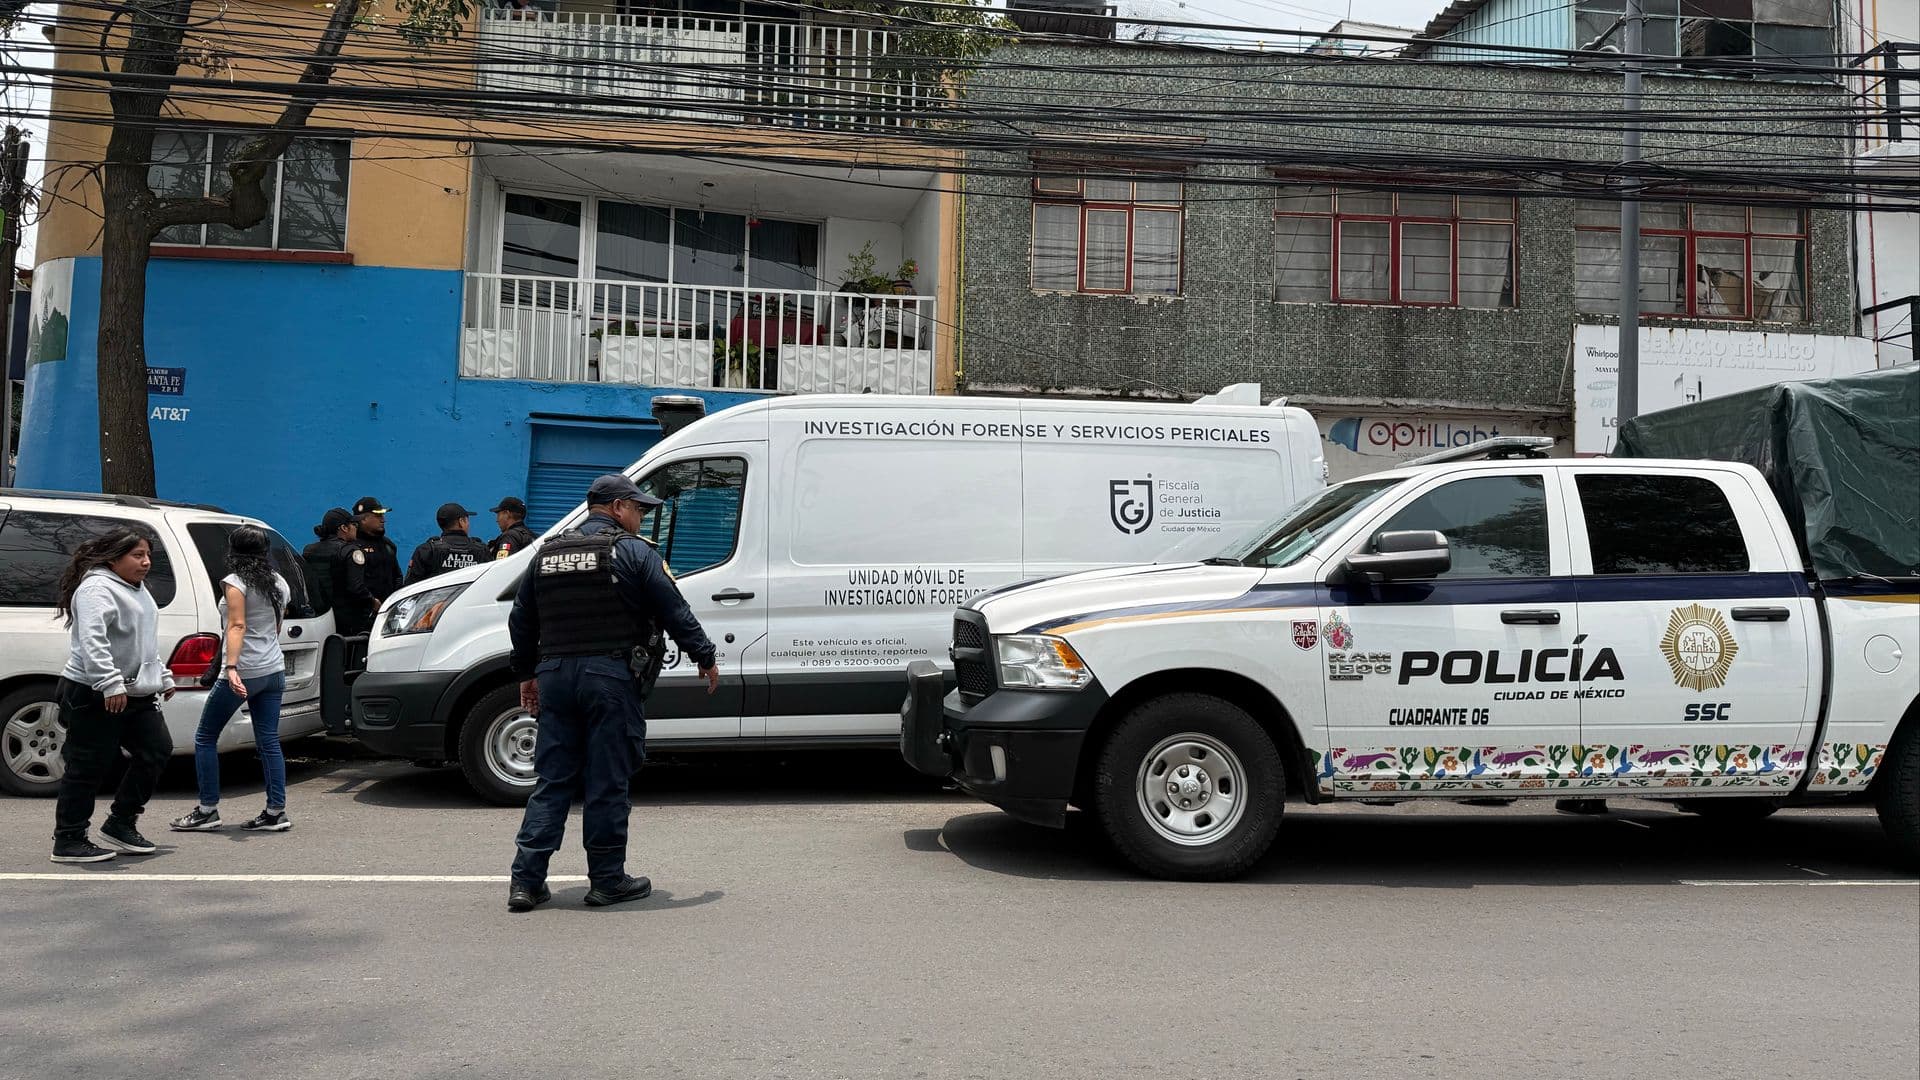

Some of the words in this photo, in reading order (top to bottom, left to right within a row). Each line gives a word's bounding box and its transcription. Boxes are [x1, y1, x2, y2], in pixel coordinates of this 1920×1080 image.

[1640, 337, 1726, 356] SERVICIO
[1733, 334, 1815, 360] TÉCNICO
[1586, 349, 1618, 359] Whirlpoo
[146, 375, 168, 386] ANTA
[170, 376, 181, 386] FE
[150, 406, 190, 421] AT&T
[805, 420, 954, 436] INVESTIGACIÓN
[962, 423, 1047, 437] FORENSE
[1053, 425, 1064, 437] Y
[1071, 425, 1165, 439] SERVICIOS
[1171, 427, 1270, 442] PERICIALES
[1158, 480, 1199, 490] Fiscalía
[1159, 494, 1203, 504] General
[1160, 508, 1174, 517] de
[1178, 508, 1221, 518] Justicia
[1197, 525, 1221, 533] México
[447, 553, 474, 562] ALTO
[542, 552, 597, 565] POLICIA
[441, 560, 453, 568] AL
[541, 561, 597, 574] SSC
[849, 569, 899, 585] UNIDAD
[904, 566, 944, 585] MÓVIL
[949, 569, 965, 584] DE
[824, 585, 925, 605] INVESTIGACIÓN
[931, 589, 988, 604] FOREN
[875, 638, 907, 646] oficial,
[770, 650, 816, 658] cualquier
[883, 648, 928, 656] repórtelo
[1328, 652, 1392, 663] RAM
[812, 659, 831, 667] 089
[843, 658, 900, 666] 5200-9000
[1398, 634, 1625, 685] POLICÍA
[1329, 664, 1392, 675] 1500
[1494, 691, 1545, 700] CIUDAD
[1550, 690, 1569, 699] DE
[1573, 687, 1625, 699] MÉXICO
[1389, 708, 1468, 725] CUADRANTE
[1471, 708, 1489, 725] 06
[1684, 703, 1731, 721] SSC
